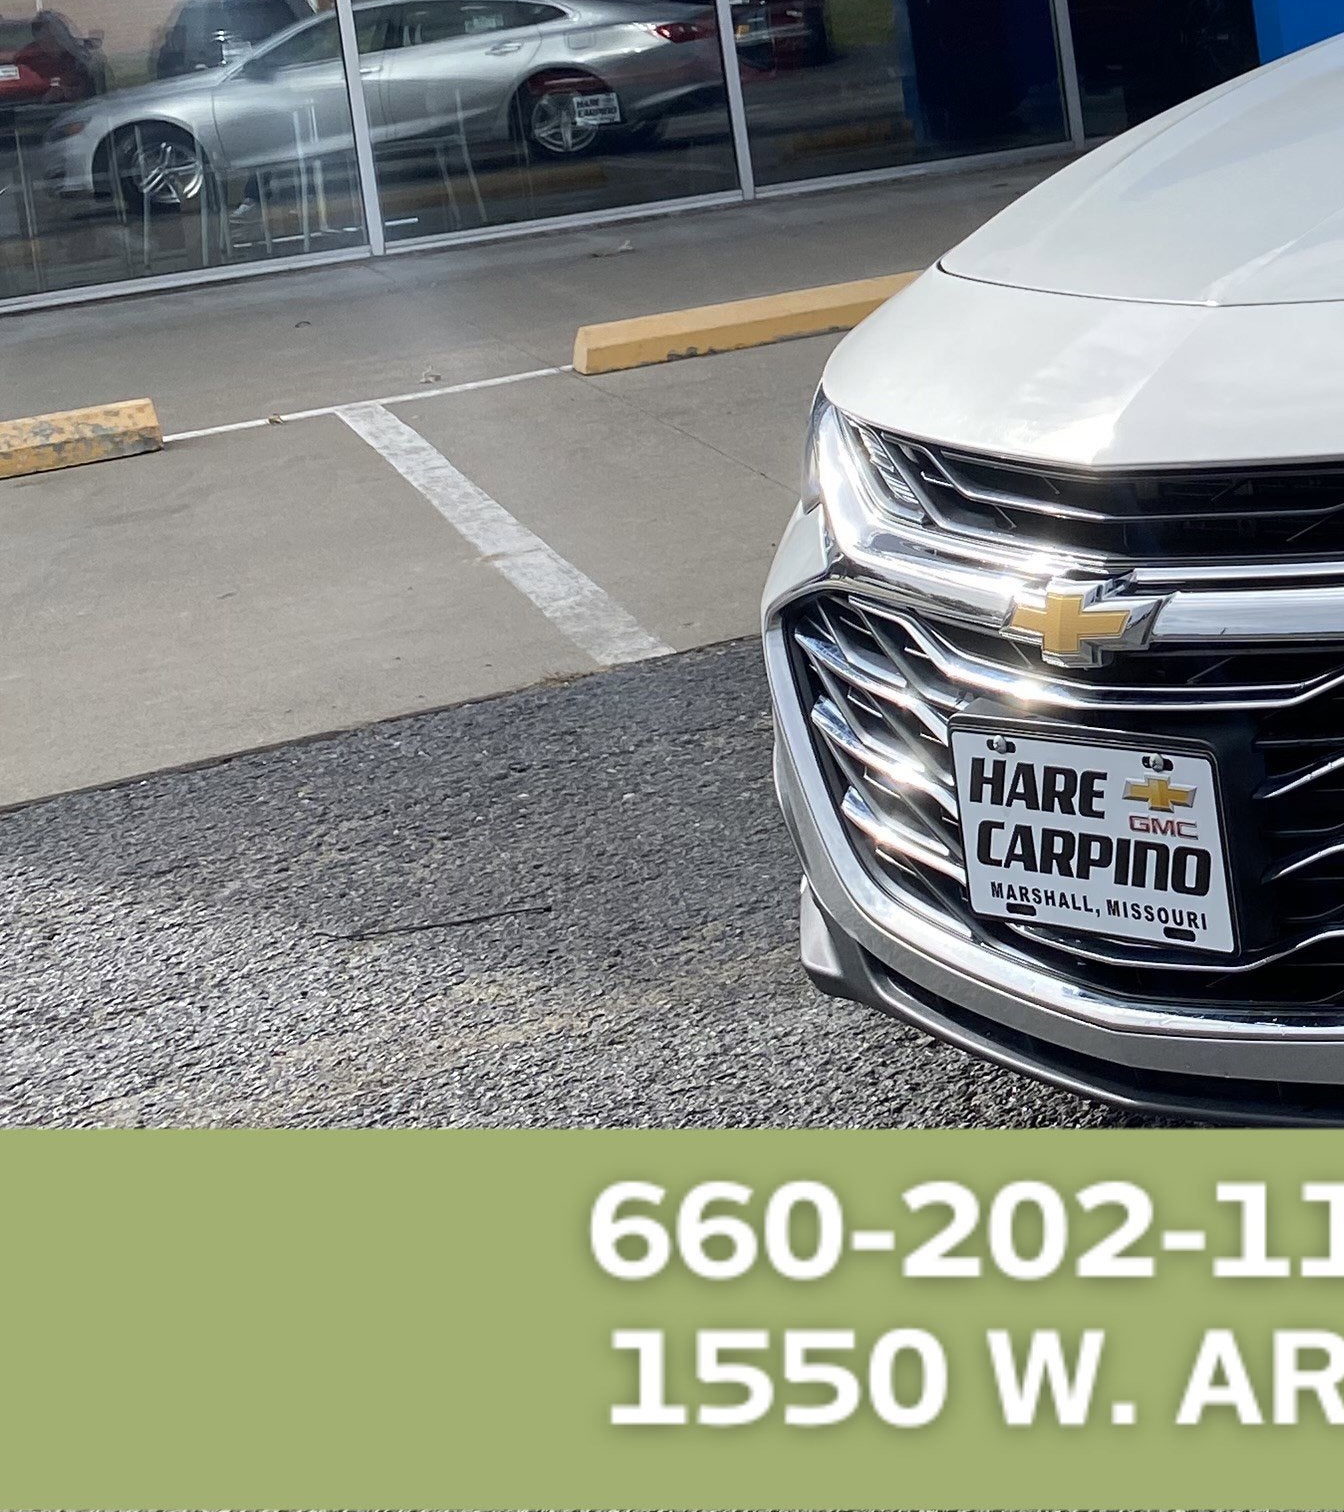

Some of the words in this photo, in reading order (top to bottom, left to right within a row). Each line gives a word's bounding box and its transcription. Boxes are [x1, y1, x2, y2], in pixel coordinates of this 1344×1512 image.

[969, 756, 1108, 820] HARE
[1128, 815, 1199, 841] GMC
[976, 819, 1212, 899] CARPINO
[990, 880, 1101, 918] MARSHALL,
[1106, 898, 1208, 932] MISSOURI
